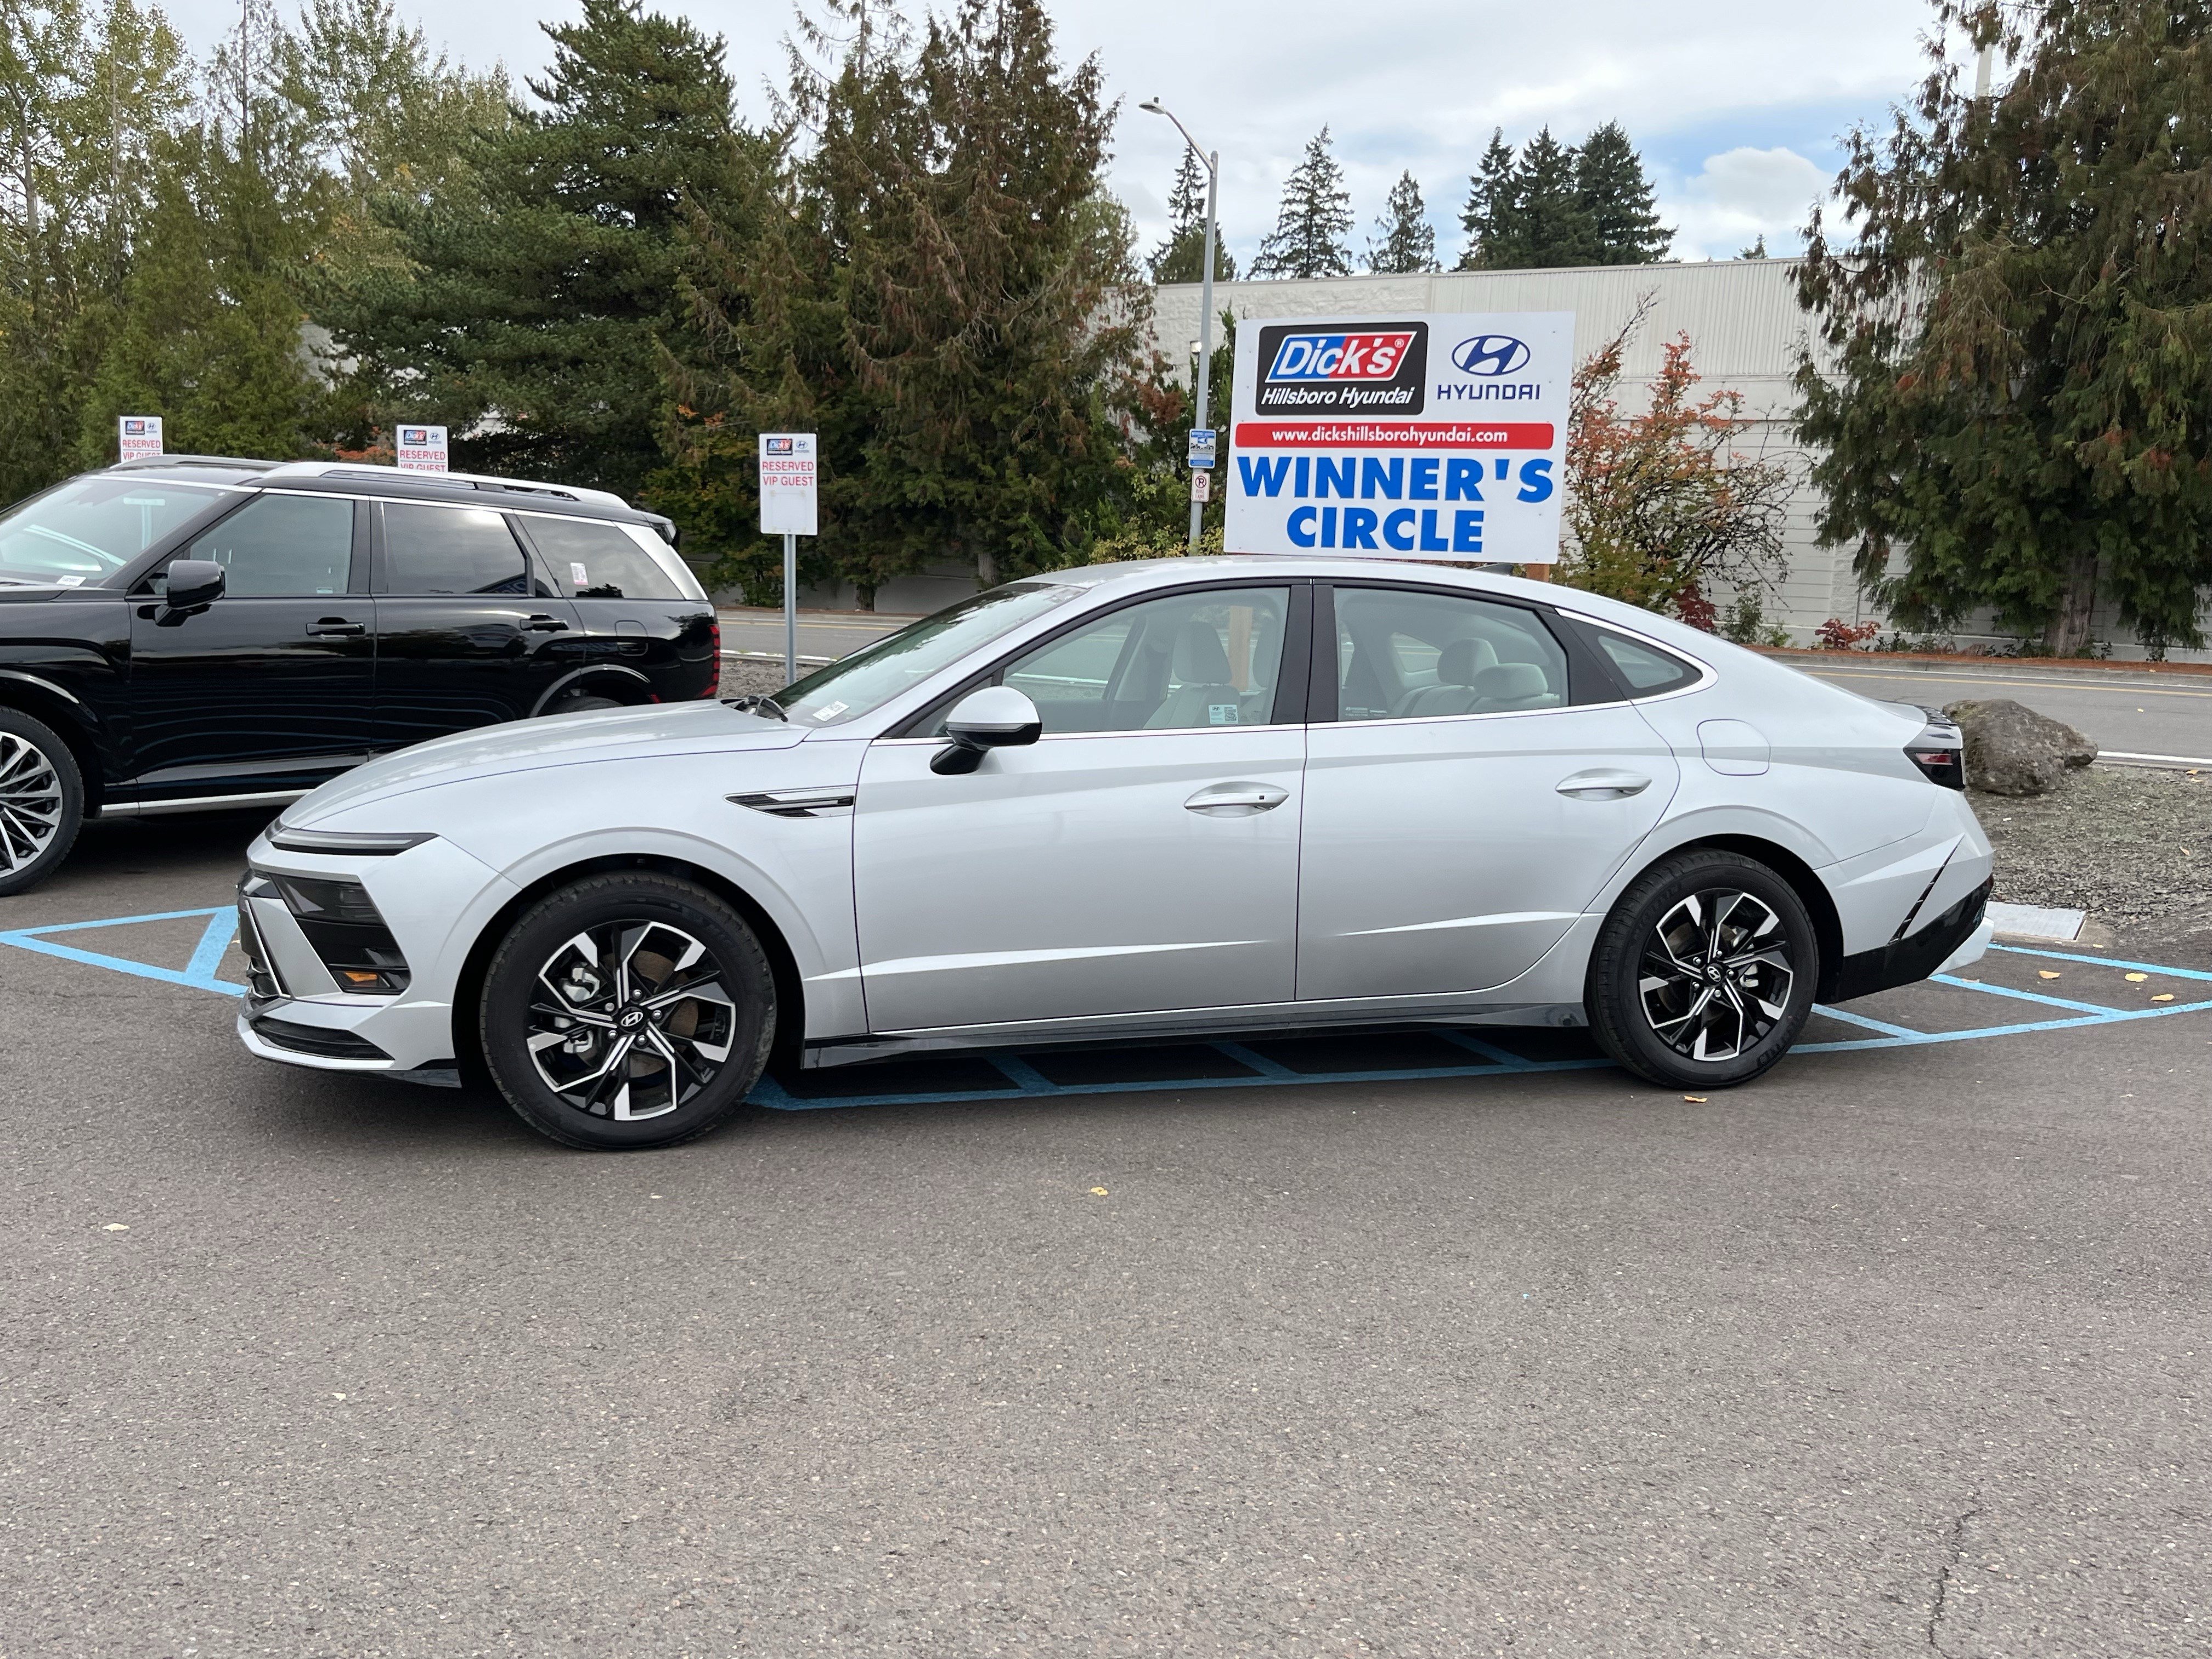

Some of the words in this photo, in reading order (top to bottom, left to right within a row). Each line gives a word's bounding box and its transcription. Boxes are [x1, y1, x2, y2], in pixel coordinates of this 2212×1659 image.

[1261, 387, 1338, 405] Hillsboro
[1339, 386, 1415, 409] Hyundai
[1437, 384, 1541, 400] HYUNDAI
[1272, 426, 1508, 446] www.dickshillsborohyundai.com
[122, 439, 161, 448] RESERVED
[123, 452, 134, 460] VIP
[399, 450, 445, 460] RESERVED
[761, 461, 815, 471] RESERVED
[763, 476, 778, 486] VIP
[781, 476, 814, 487] GUEST
[1237, 456, 1554, 504] WINNER'S
[1286, 506, 1485, 553] CIRCLE
